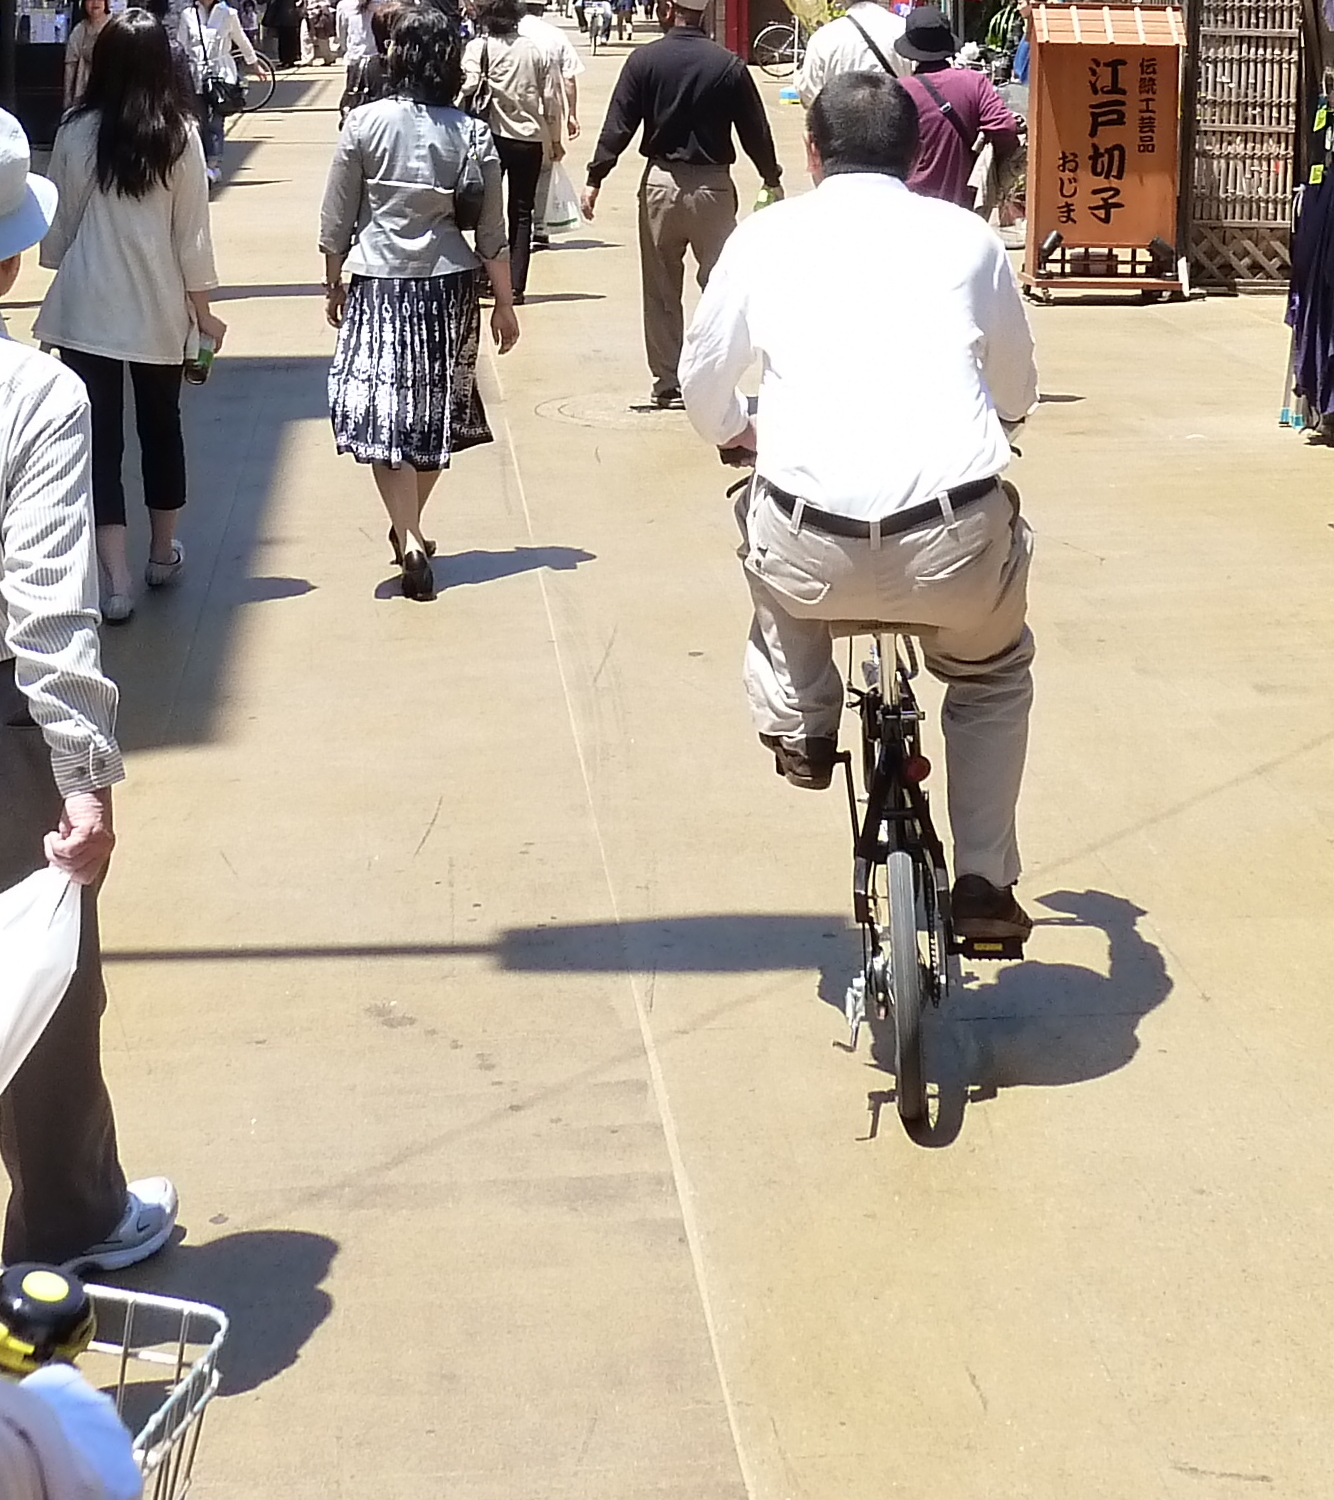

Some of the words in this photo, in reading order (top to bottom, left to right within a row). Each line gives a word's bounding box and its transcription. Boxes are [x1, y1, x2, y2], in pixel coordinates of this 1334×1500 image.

[1087, 57, 1128, 224] 江戸切子
[1138, 57, 1158, 154] 伝統工芸品
[1056, 151, 1080, 225] おじま
